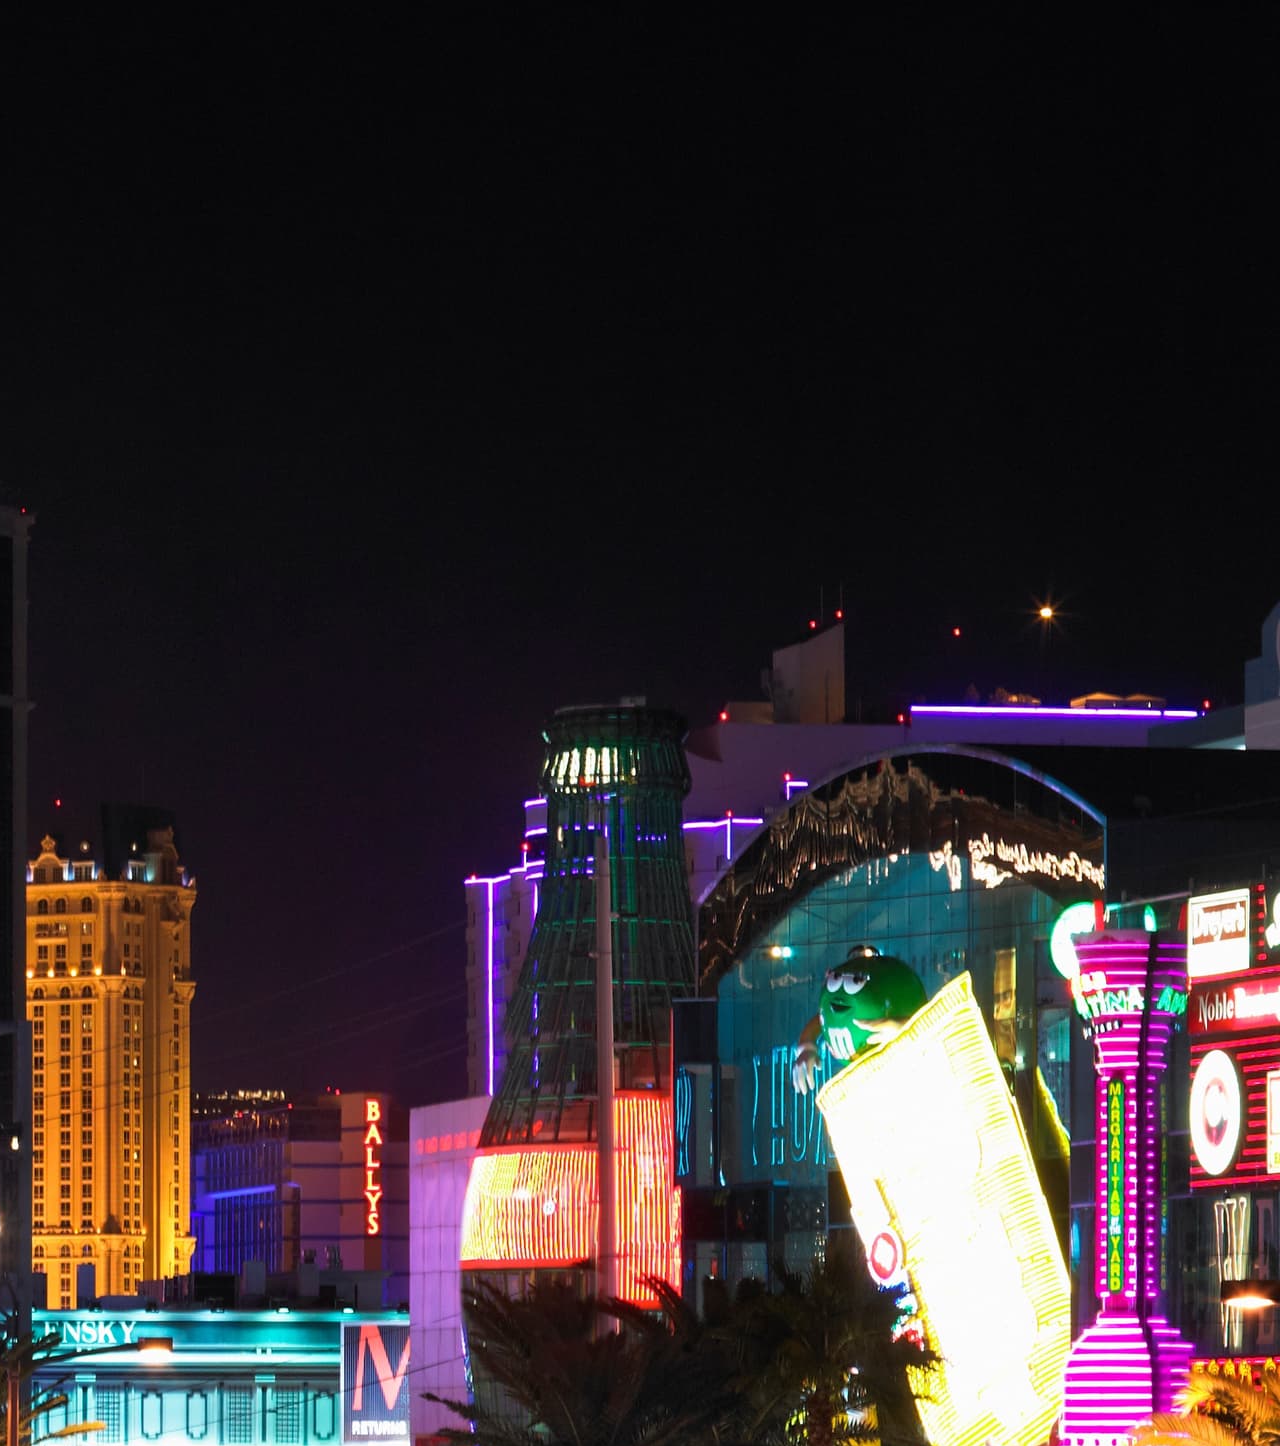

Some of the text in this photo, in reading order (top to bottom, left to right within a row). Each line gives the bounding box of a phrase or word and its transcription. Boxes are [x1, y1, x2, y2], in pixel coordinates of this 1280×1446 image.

[364, 1100, 382, 1235] BALLYS
[1109, 1083, 1122, 1216] MARGARITAS
[1109, 1236, 1122, 1291] YARD
